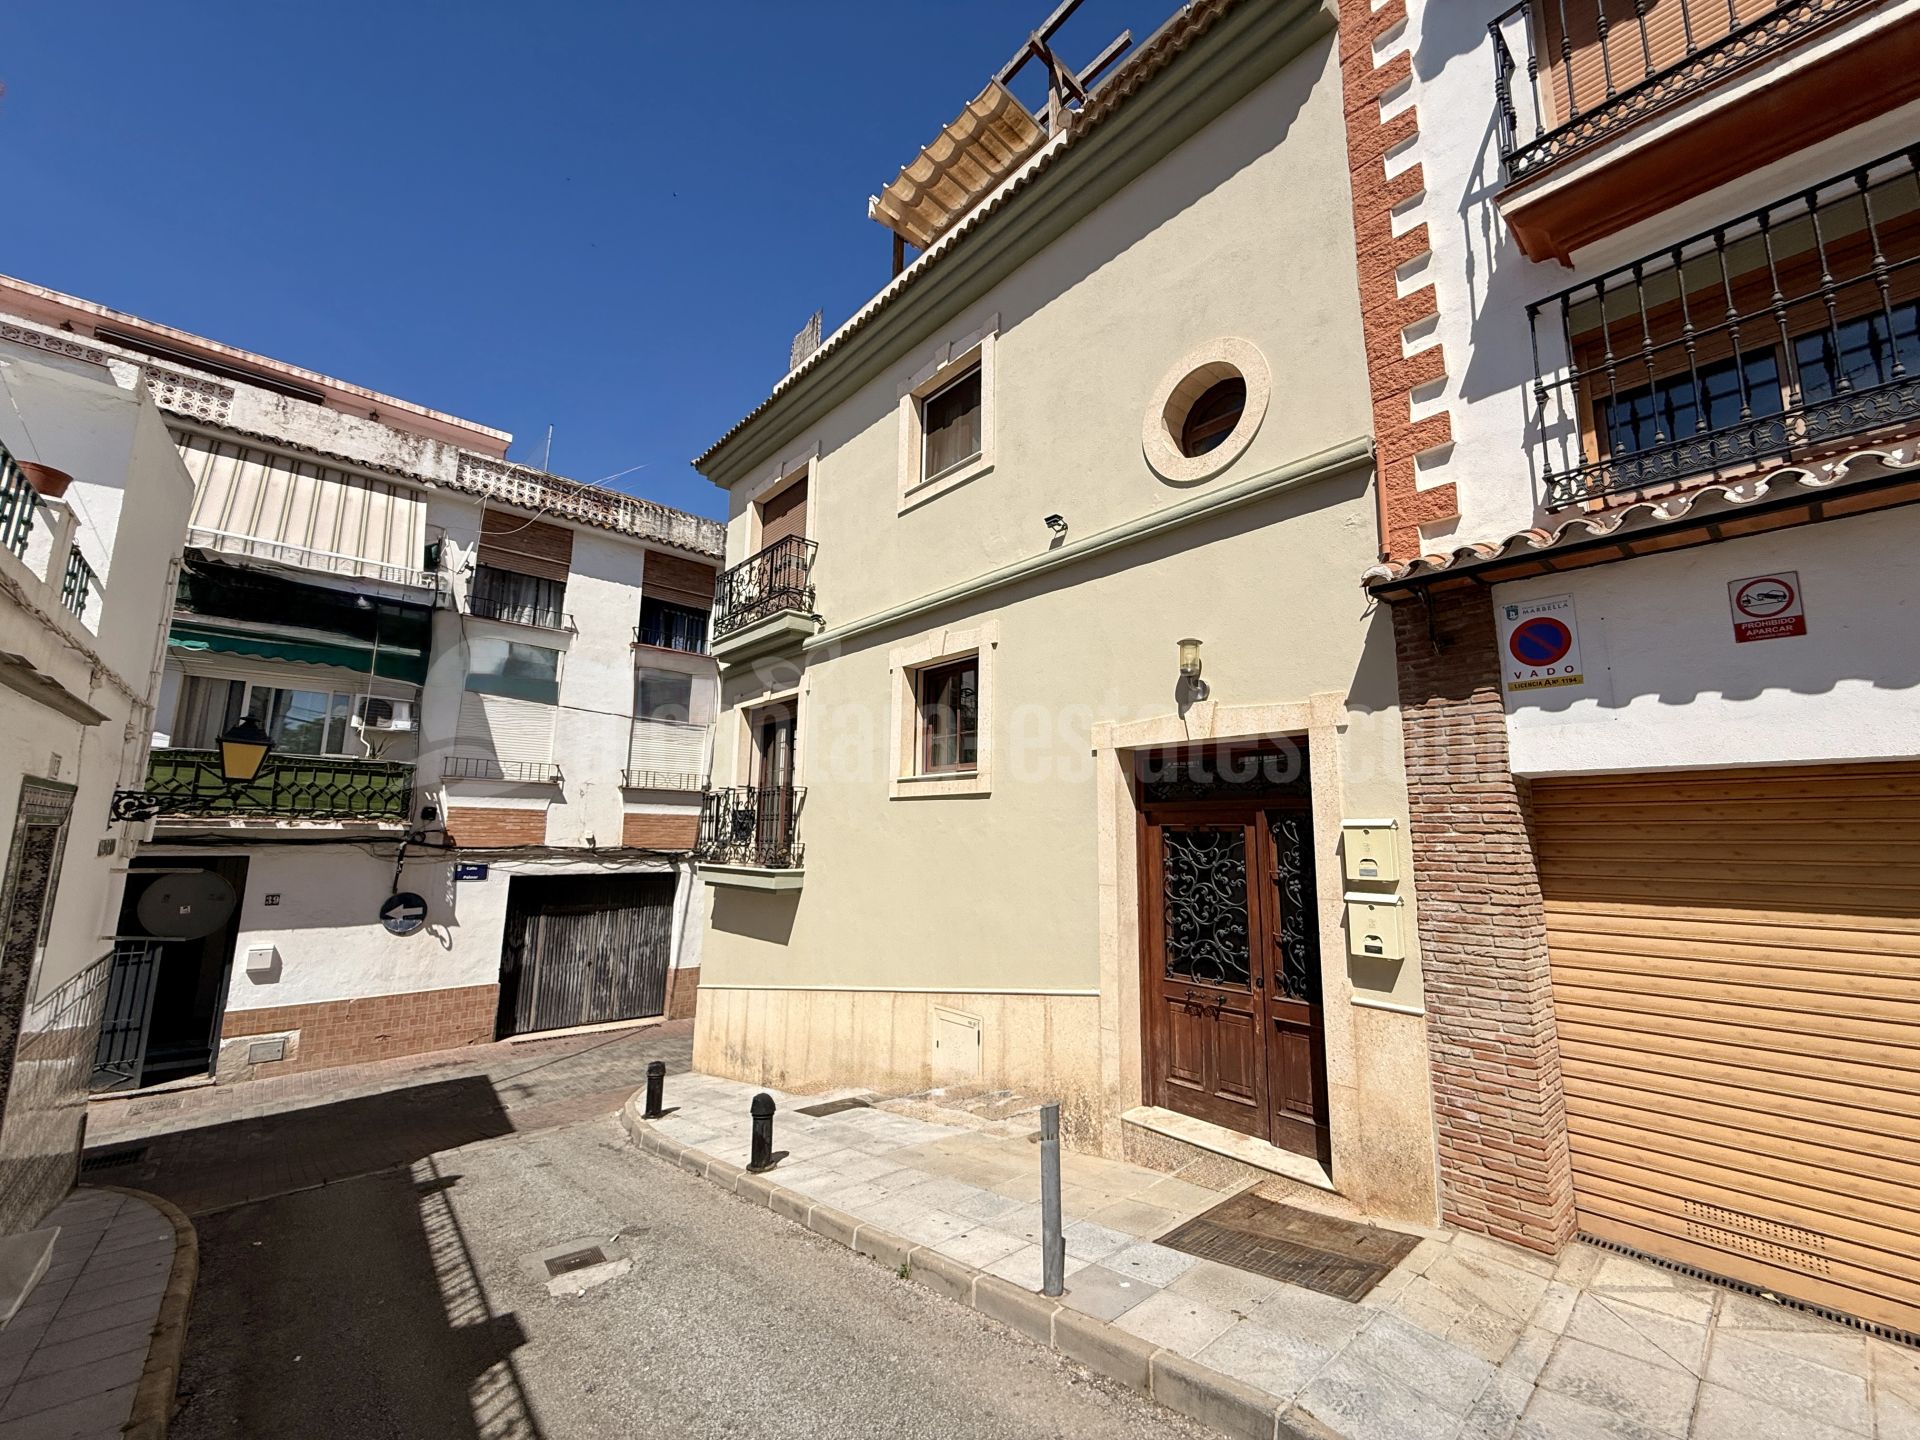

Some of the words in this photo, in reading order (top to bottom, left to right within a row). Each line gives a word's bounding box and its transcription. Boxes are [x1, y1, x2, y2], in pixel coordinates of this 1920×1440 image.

[1522, 604, 1569, 615] MARBELLA
[1742, 617, 1796, 630] PROHIBIDO
[1746, 625, 1793, 636] APARCAR
[1514, 665, 1574, 679] VADO
